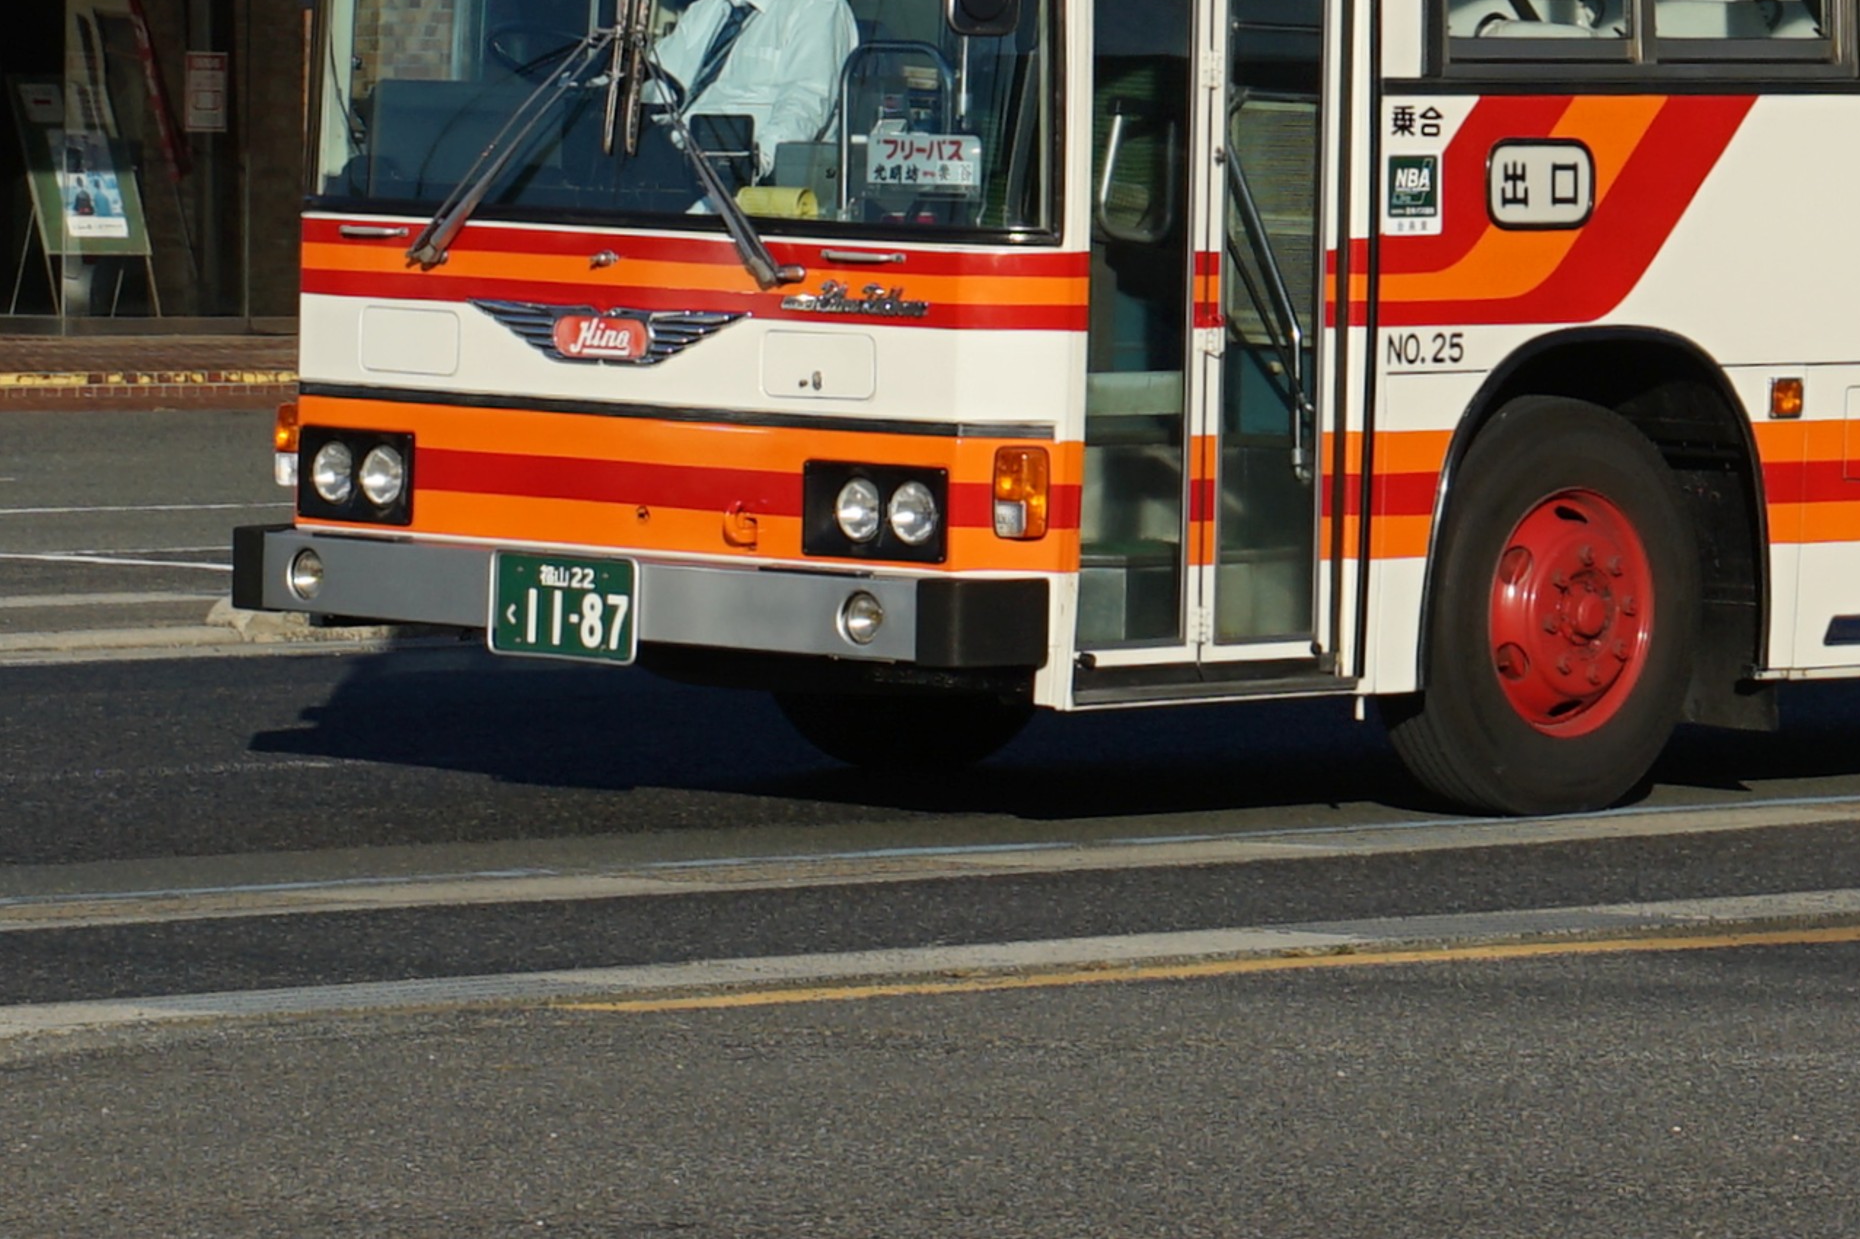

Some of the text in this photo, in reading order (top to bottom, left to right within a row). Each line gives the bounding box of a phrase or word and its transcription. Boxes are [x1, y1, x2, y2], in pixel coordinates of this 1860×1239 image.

[1391, 105, 1444, 137] 乗合
[883, 139, 963, 161] フリーバス
[1395, 167, 1431, 189] NBA
[1501, 161, 1579, 208] 出口
[570, 317, 631, 356] Hino
[506, 587, 629, 651] く 11-87
